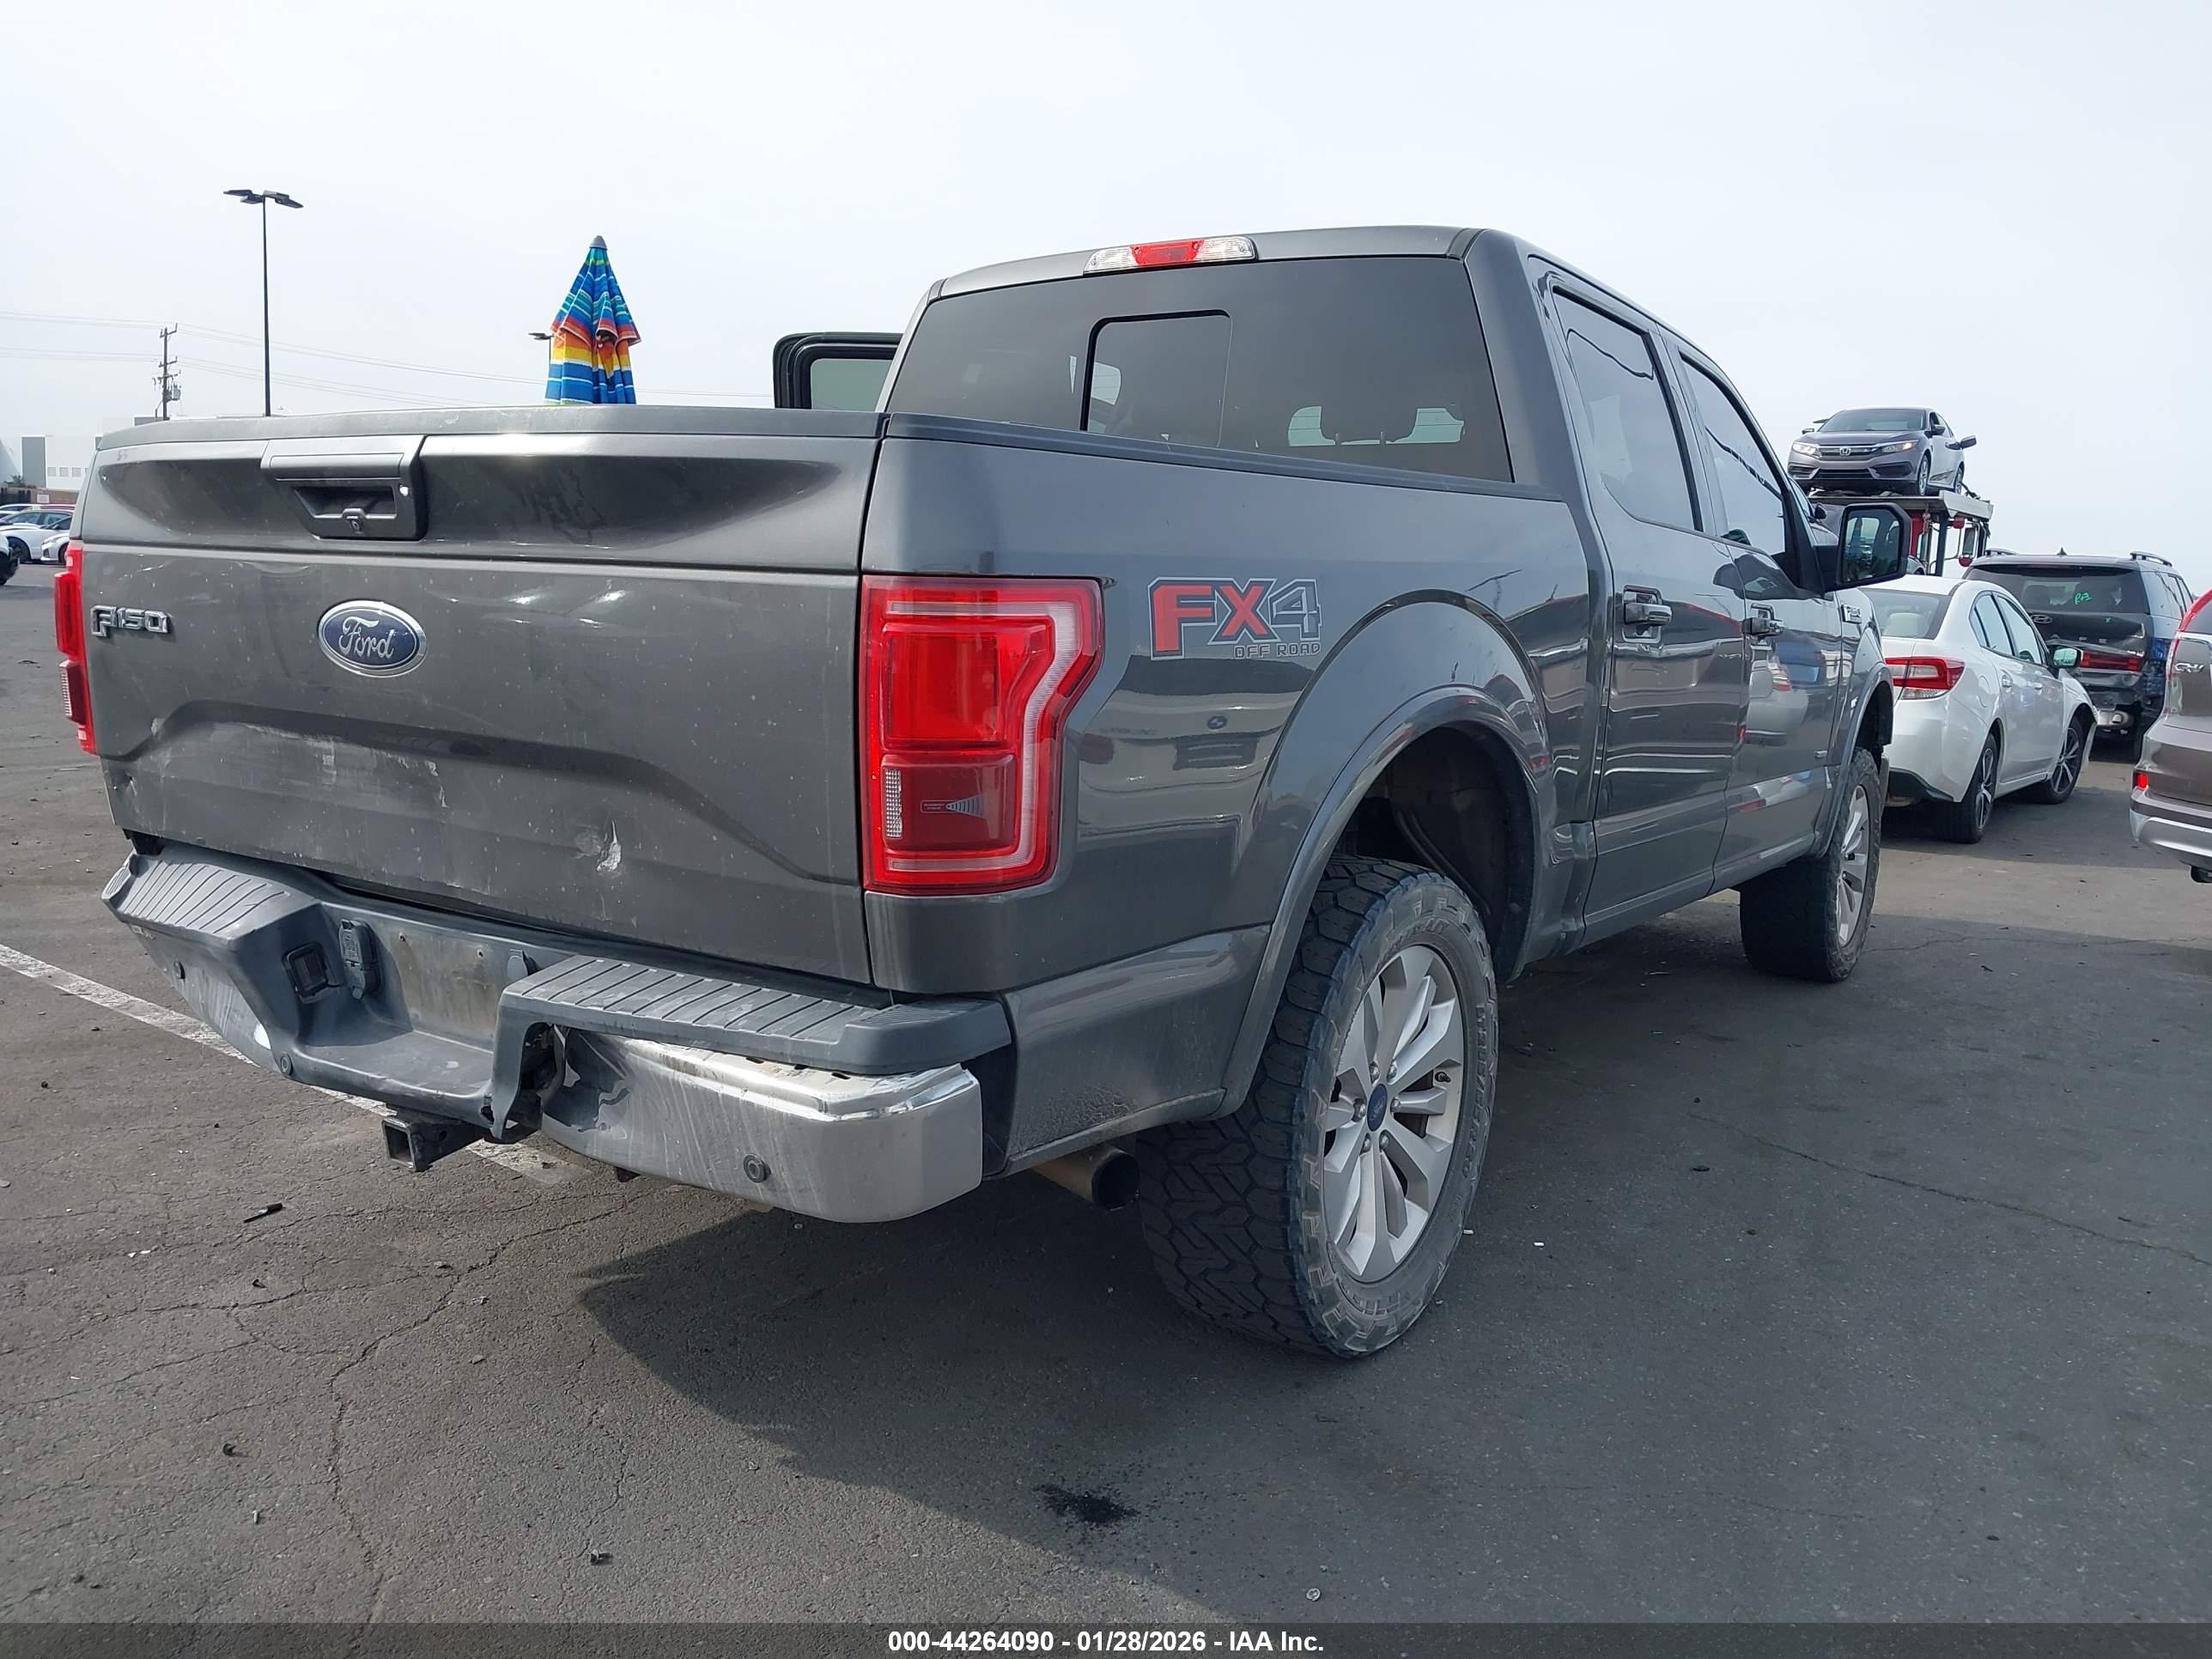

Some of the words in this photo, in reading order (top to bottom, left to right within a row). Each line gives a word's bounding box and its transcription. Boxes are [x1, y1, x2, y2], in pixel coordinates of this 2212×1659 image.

[338, 616, 395, 659] Ford
[1147, 576, 1322, 660] FX4
[1233, 644, 1271, 659] OFF
[1276, 641, 1322, 657] ROAD
